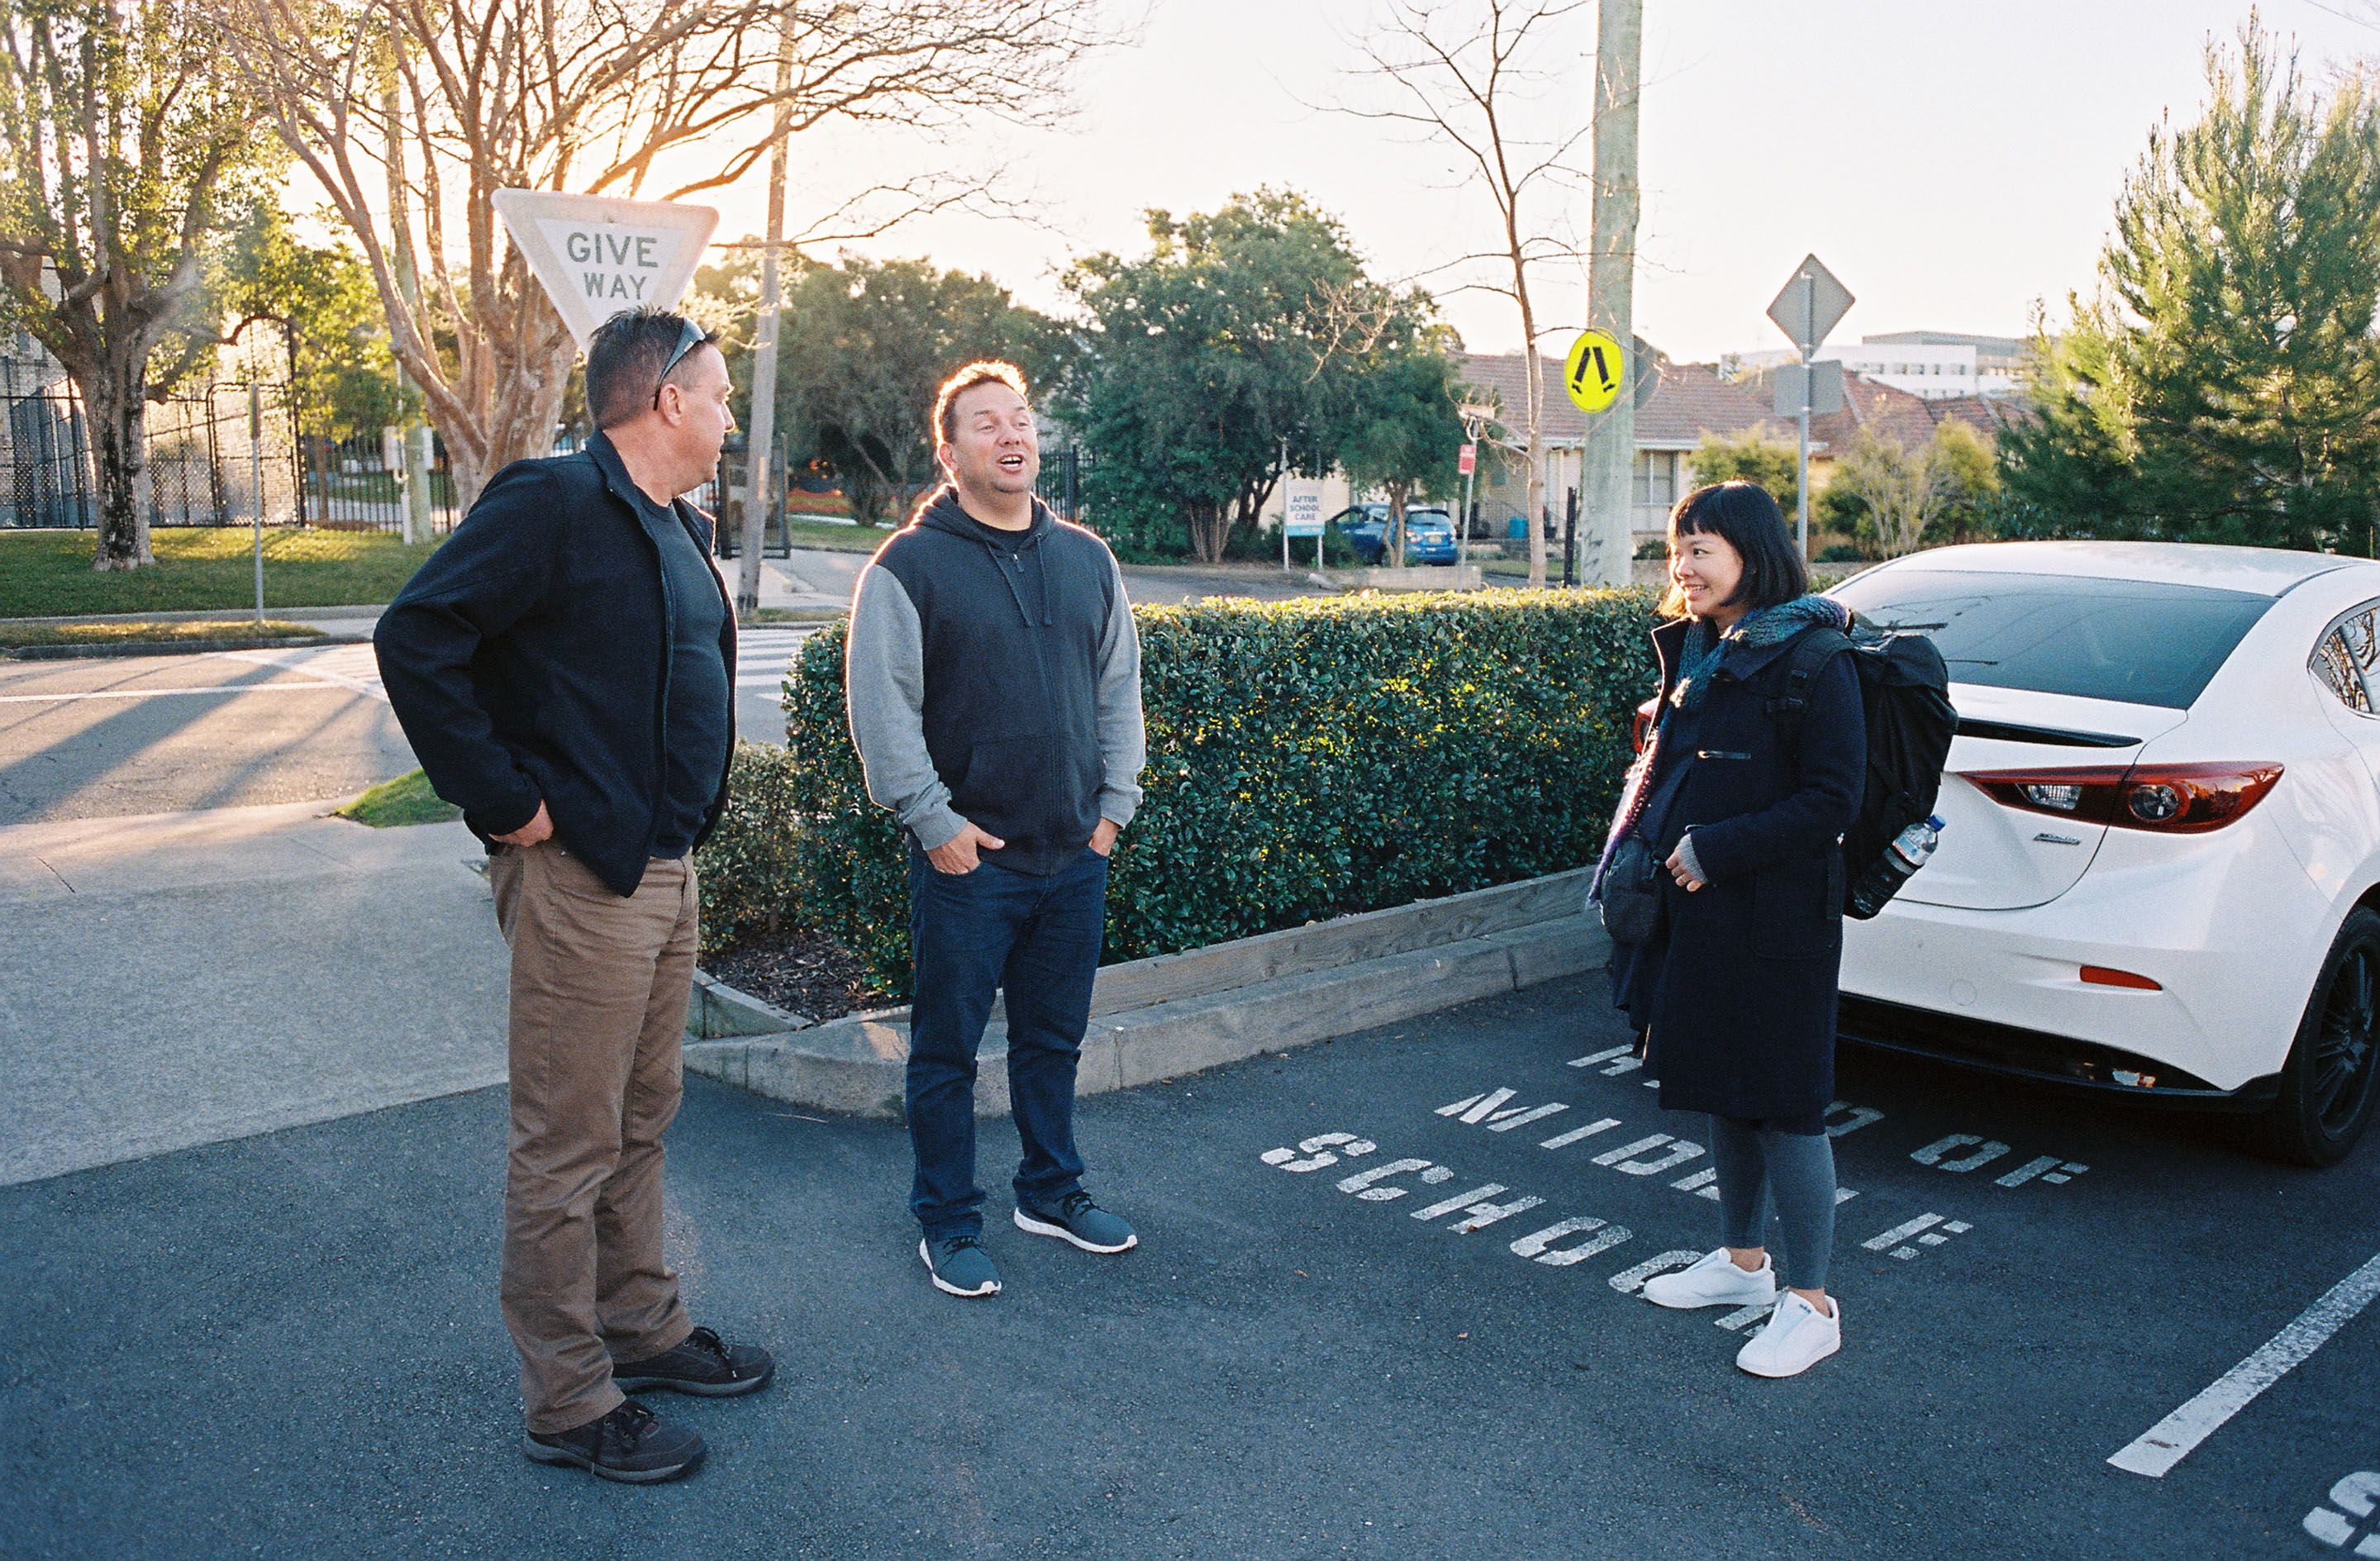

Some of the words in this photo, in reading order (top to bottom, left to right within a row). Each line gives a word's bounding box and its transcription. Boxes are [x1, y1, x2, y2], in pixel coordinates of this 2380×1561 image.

[567, 232, 658, 268] GIVE
[583, 273, 646, 300] WAY
[1289, 504, 1321, 512] SCHOOL
[1294, 512, 1316, 521] CARE
[1434, 1087, 1973, 1260] MIDE
[1910, 1133, 2090, 1188] OF
